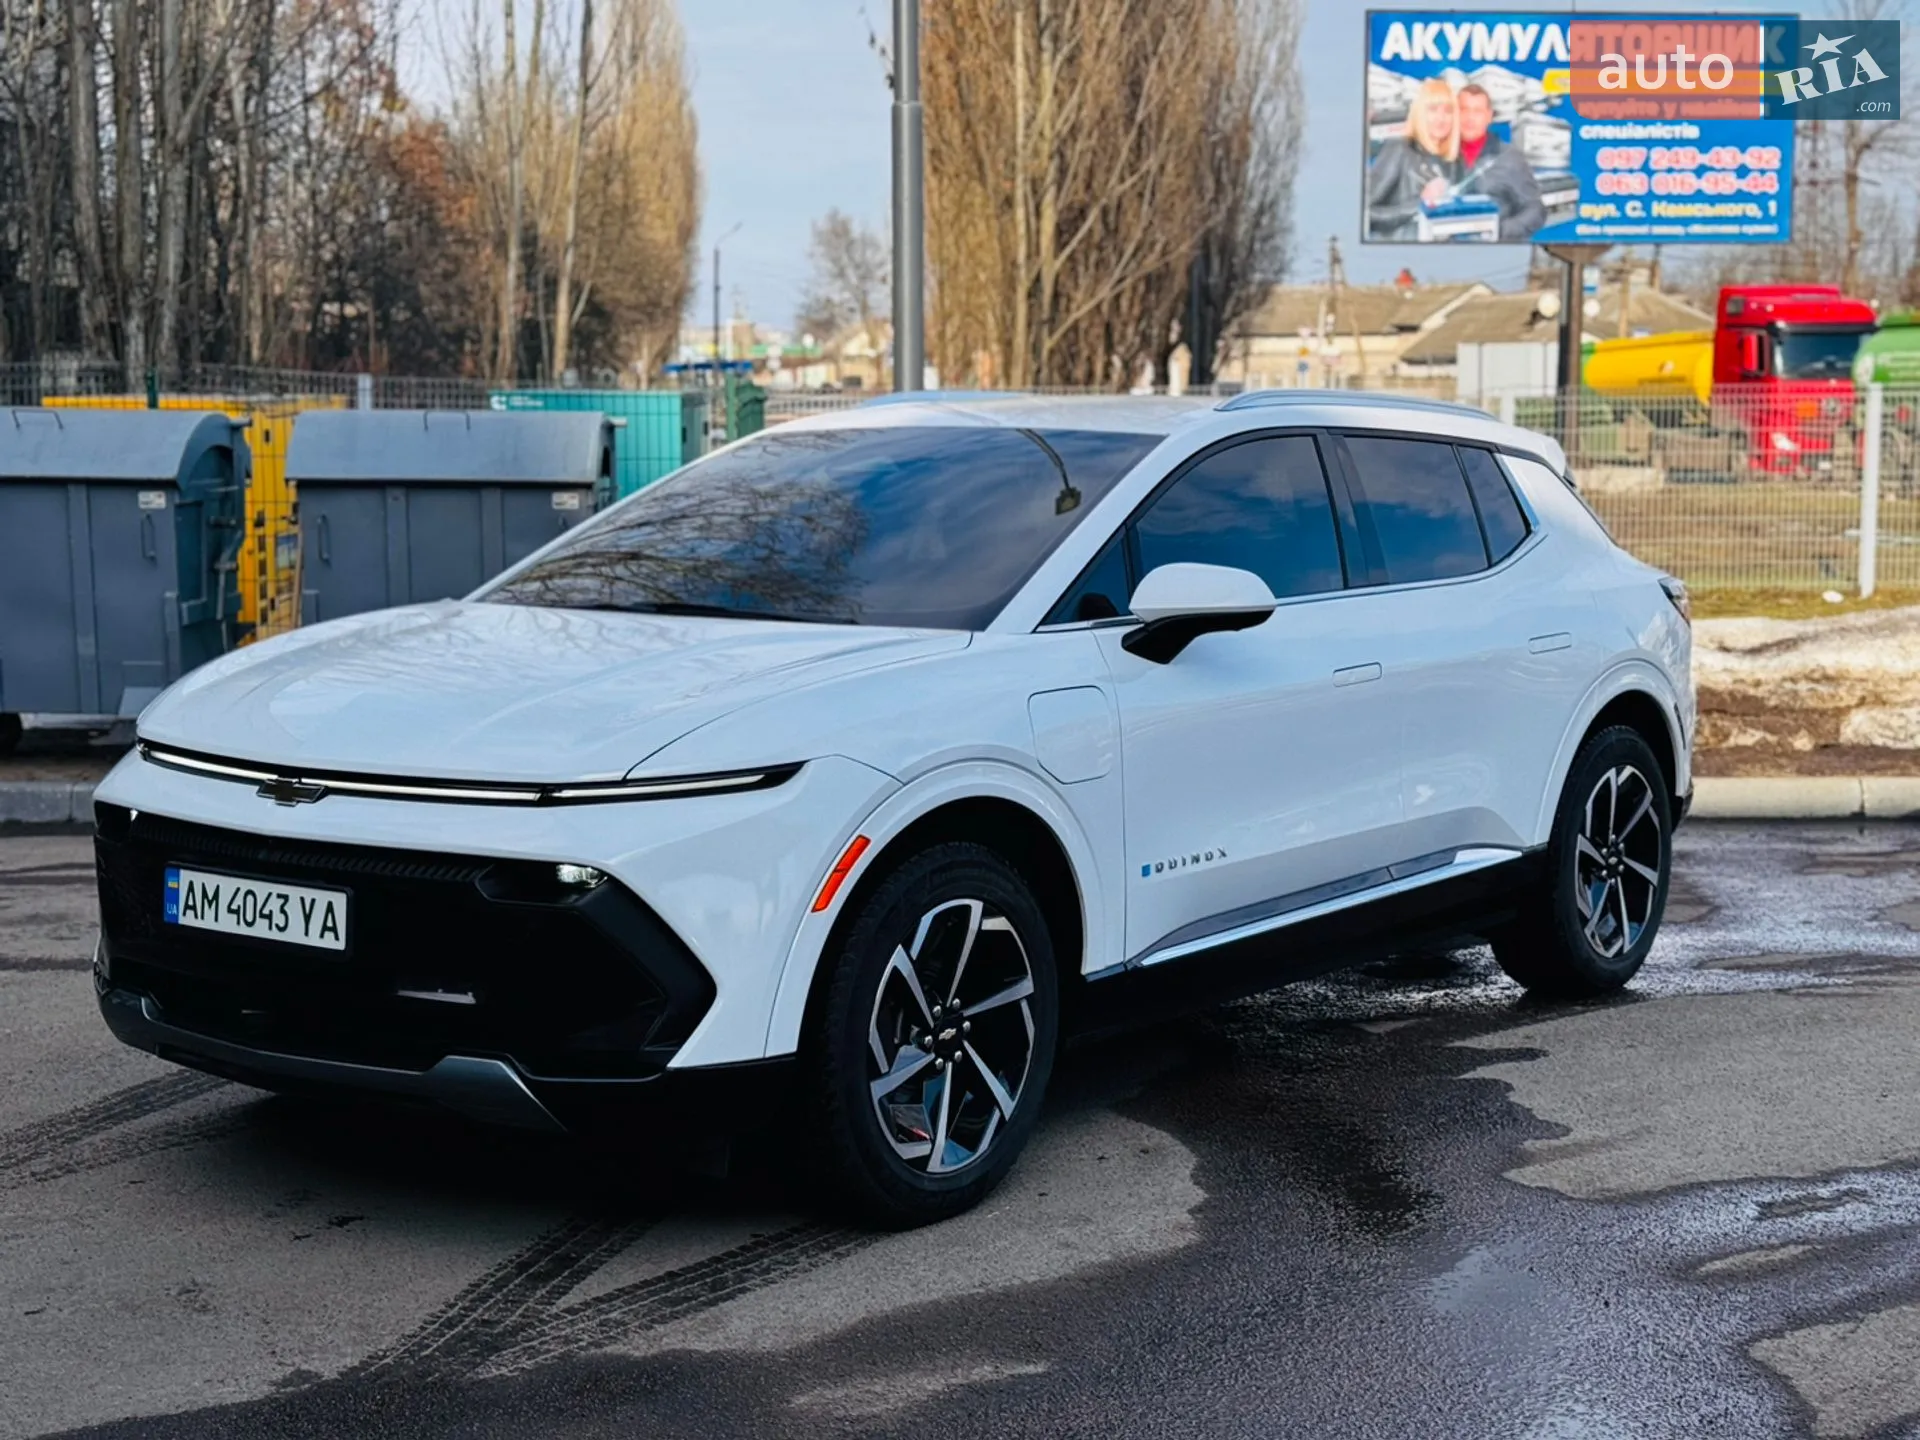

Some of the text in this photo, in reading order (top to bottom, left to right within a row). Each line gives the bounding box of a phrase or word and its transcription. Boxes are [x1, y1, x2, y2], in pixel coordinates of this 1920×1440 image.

[166, 903, 178, 915] UA
[182, 880, 340, 941] AM 4043 YA
